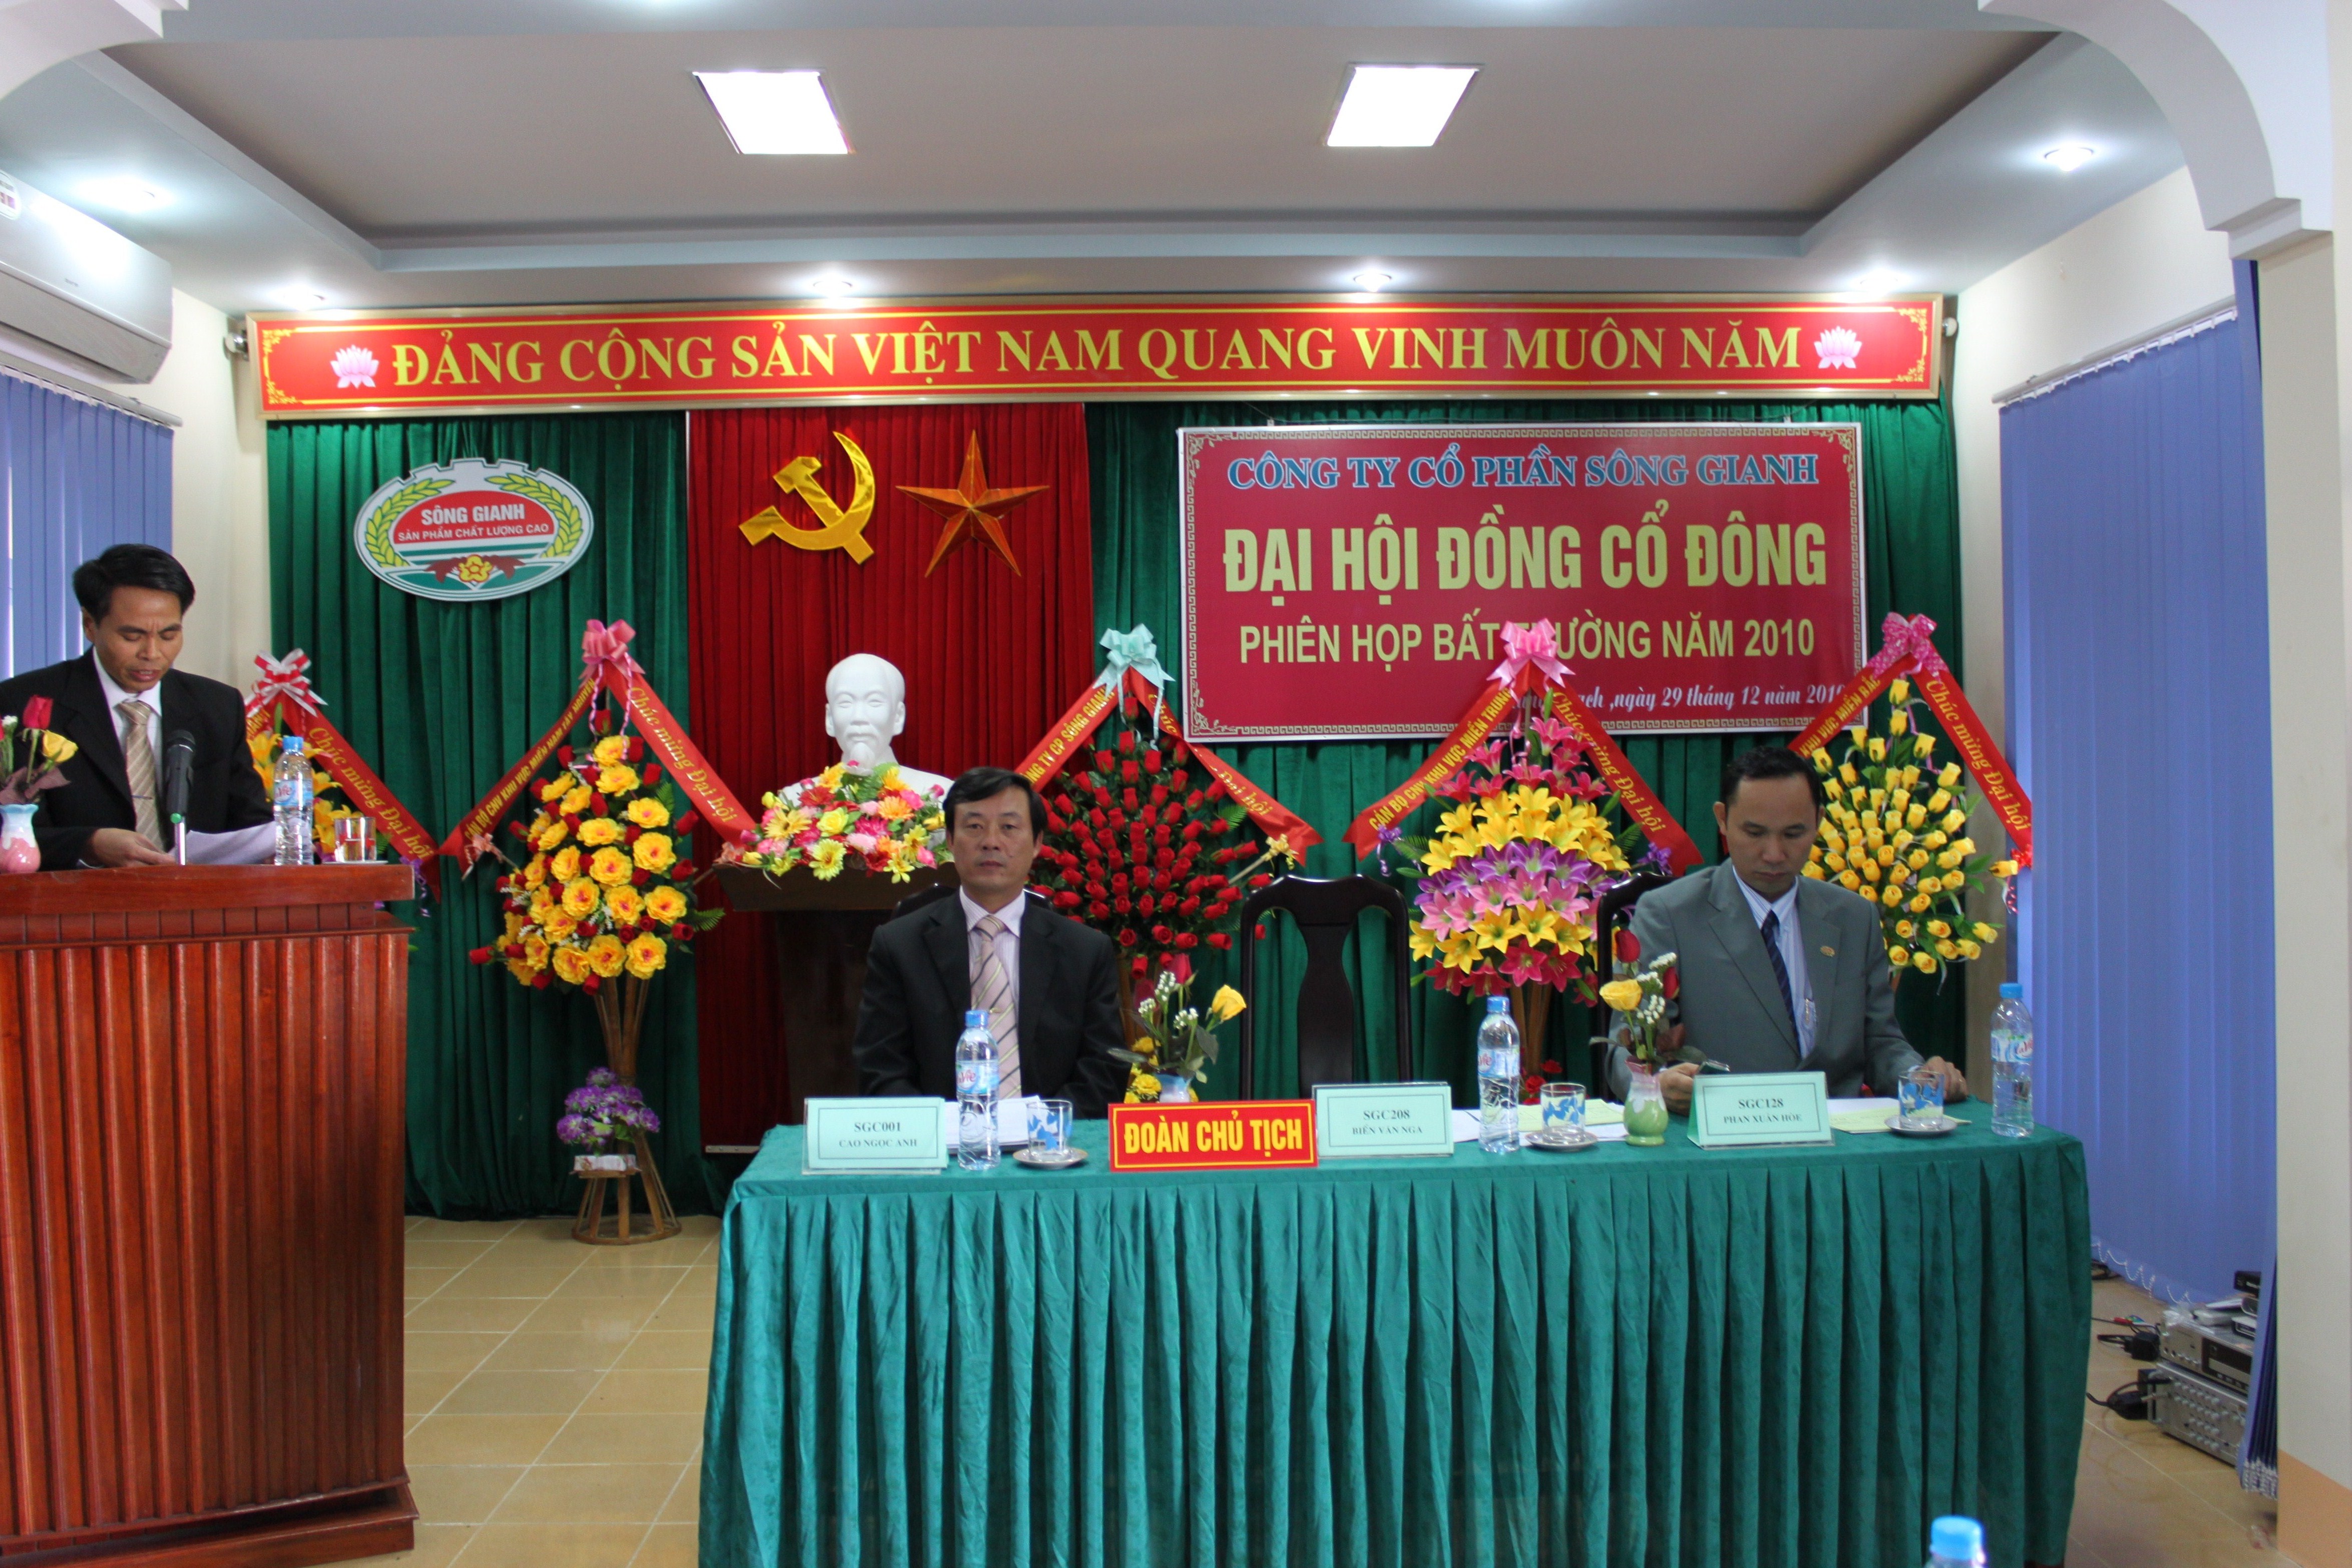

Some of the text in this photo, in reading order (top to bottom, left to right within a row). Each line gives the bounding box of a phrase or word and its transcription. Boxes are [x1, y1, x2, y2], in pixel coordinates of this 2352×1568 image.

[391, 317, 1802, 390] ĐẢNG CỘNG SẢN VIỆT NAM QUANG VINH MUÔN NĂM
[1228, 442, 1819, 489] CÔNG TY CỔ PHẦN SÔNG GIANH
[398, 530, 420, 541] SẢN
[423, 526, 453, 539] PHẨM
[455, 525, 483, 537] CHẤT
[526, 524, 549, 533] CAO
[421, 504, 525, 525] SÔNG GIANH
[1223, 499, 1826, 606] ĐẠI HỘI ĐỒNG CỔ ĐÔNG
[1240, 615, 1340, 663] PHIÊN
[1352, 623, 1422, 672] HỌP
[1433, 608, 1500, 661] BẤT
[1662, 611, 1734, 657] NĂM
[1744, 619, 1815, 656] 2010
[1661, 687, 1683, 706] 29
[1686, 684, 1735, 710] tháng
[1741, 685, 1760, 705] 12
[1817, 716, 1839, 739] VỰC
[1835, 692, 1862, 721] MIỀN
[626, 687, 737, 822] Chúc mừng Đại hội
[1037, 750, 1056, 767] TY
[1049, 737, 1065, 755] CP
[1060, 713, 1090, 742] SÔNG
[1551, 692, 1584, 731] Chúc
[1614, 776, 1639, 802] Đại
[1635, 802, 1666, 833] hội
[1926, 680, 2032, 831] Chúc mừng Đại hội
[1369, 806, 1395, 831] CÁN
[1388, 795, 1409, 813] BỘ
[1424, 762, 1448, 784] KHU
[1441, 744, 1466, 767] VỰC
[1459, 718, 1489, 749] MIỀN
[341, 766, 384, 809] mừng
[378, 807, 405, 835] Đại
[402, 831, 436, 859] hội
[854, 1121, 901, 1132] SGC001
[1363, 1109, 1410, 1120] SGC208
[1723, 1115, 1750, 1123] PHAN
[1738, 1098, 1784, 1109] SGC128
[839, 1138, 918, 1148] CAO NGỌC ANH
[1124, 1109, 1303, 1157] ĐOÀN CHỦ TỊCH
[1401, 1125, 1423, 1134] NGA
